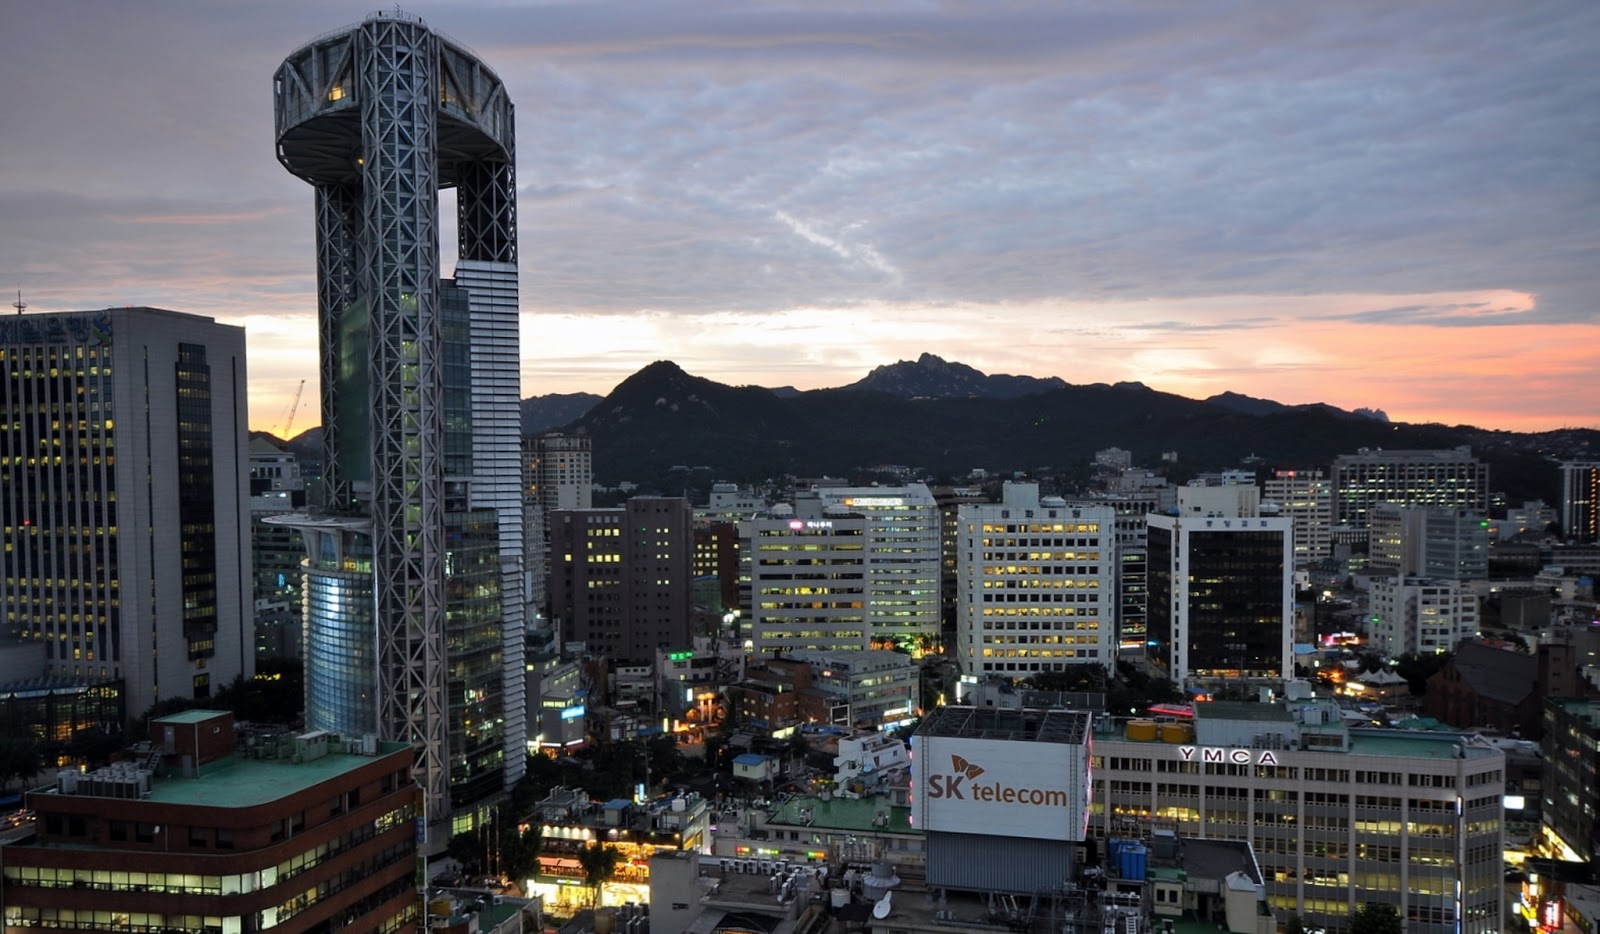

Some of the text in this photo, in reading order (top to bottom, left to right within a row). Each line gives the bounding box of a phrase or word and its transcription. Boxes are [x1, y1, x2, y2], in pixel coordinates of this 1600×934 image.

[1179, 746, 1278, 765] YMCA
[928, 774, 1067, 807] SK telecom
